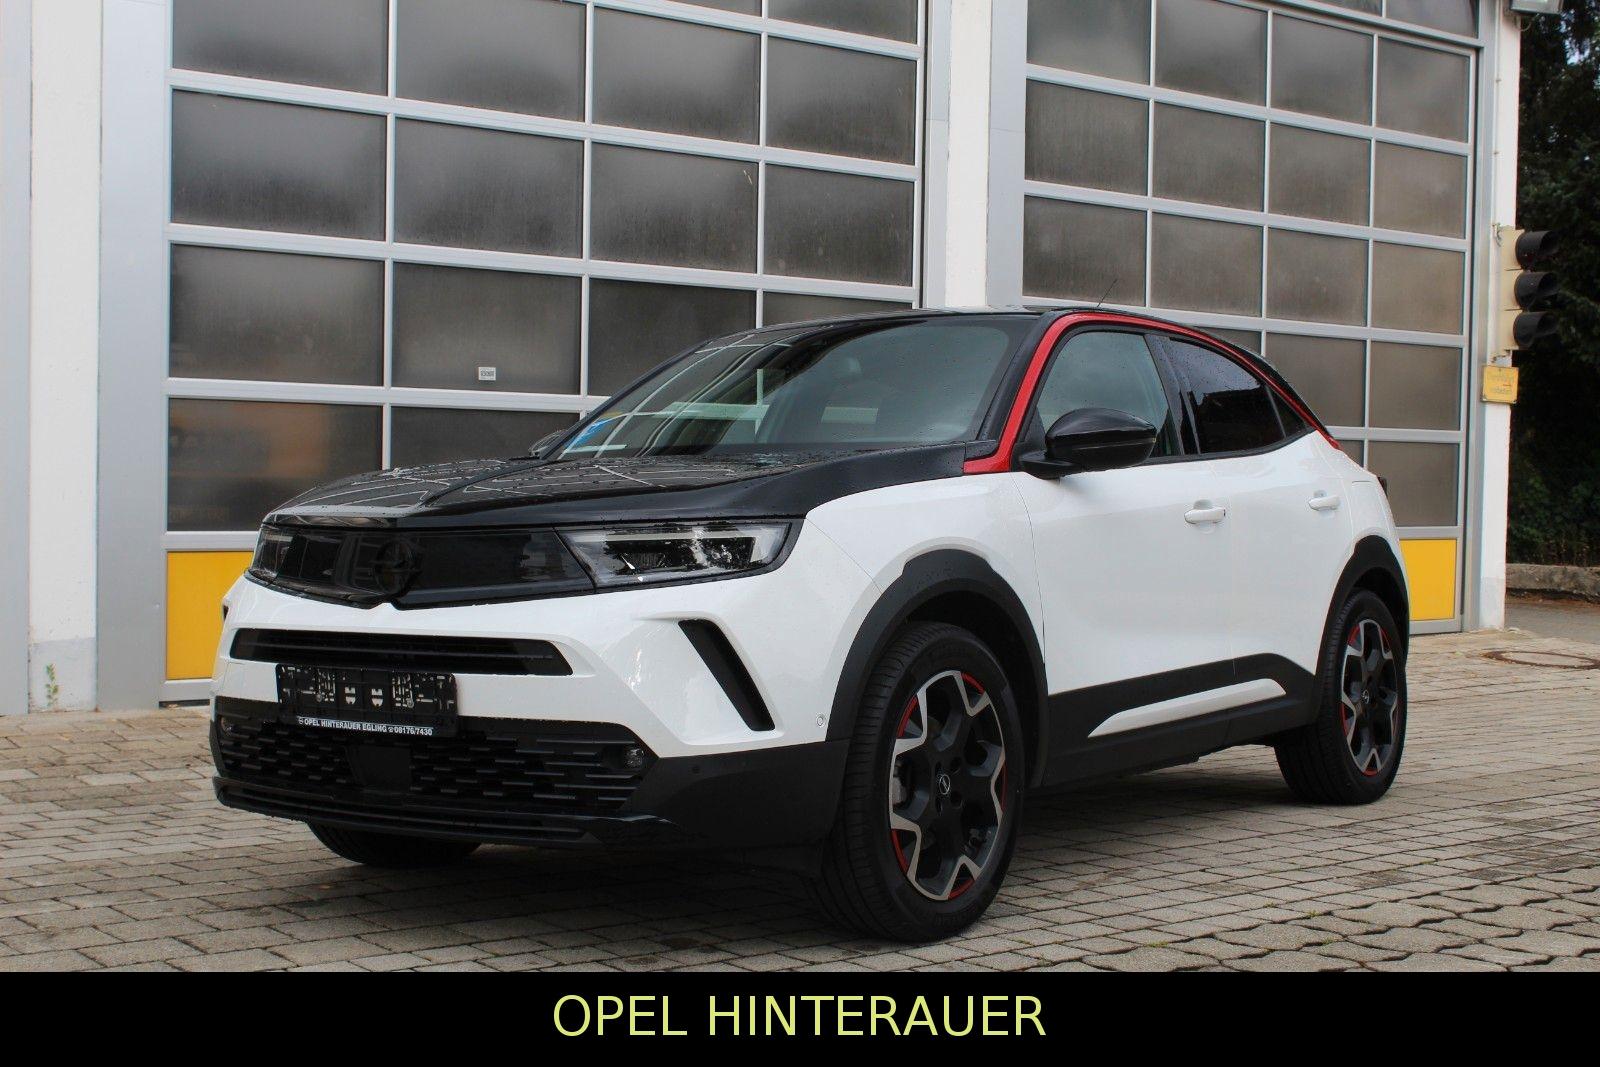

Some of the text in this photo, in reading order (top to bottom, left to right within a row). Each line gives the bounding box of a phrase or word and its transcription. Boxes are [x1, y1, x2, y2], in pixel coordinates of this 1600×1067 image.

[304, 718, 320, 726] OPEL
[321, 720, 361, 730] HINTERAUER
[362, 723, 387, 732] EGLING
